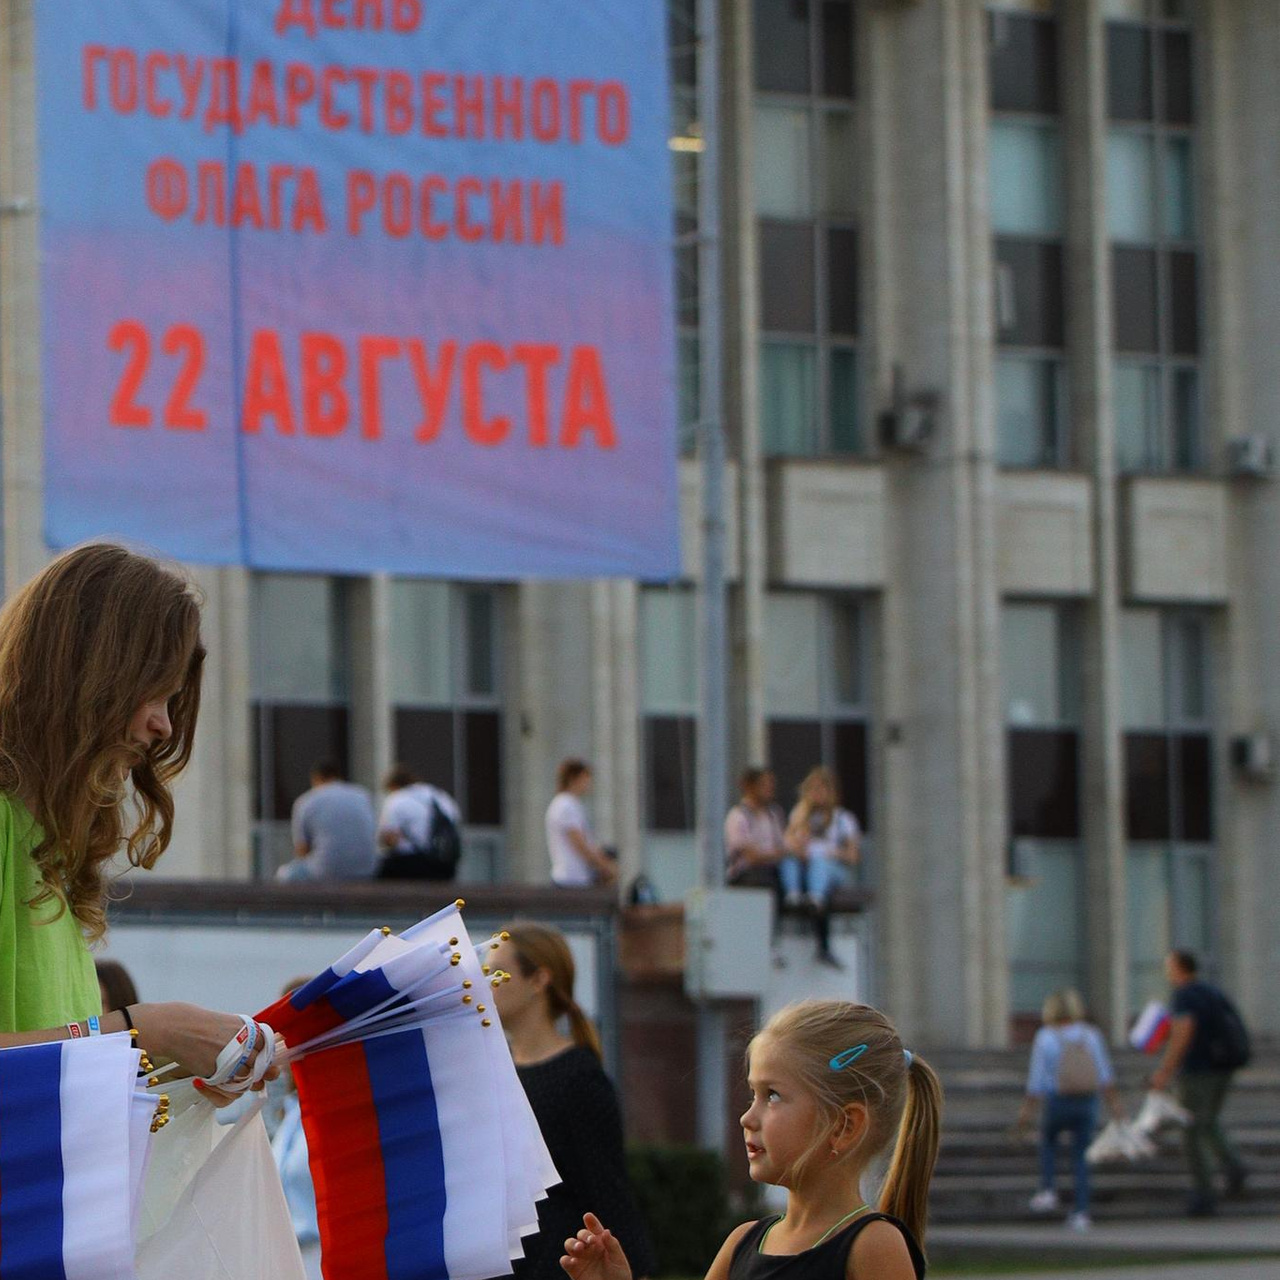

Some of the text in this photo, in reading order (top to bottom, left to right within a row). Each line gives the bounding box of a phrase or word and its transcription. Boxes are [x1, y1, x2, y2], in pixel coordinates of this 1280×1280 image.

[84, 46, 627, 144] ГОСУДАРСТВЕННОГО
[148, 159, 564, 245] ФЛАГА РОССИИ
[109, 320, 616, 448] 22 АВГУСТА
